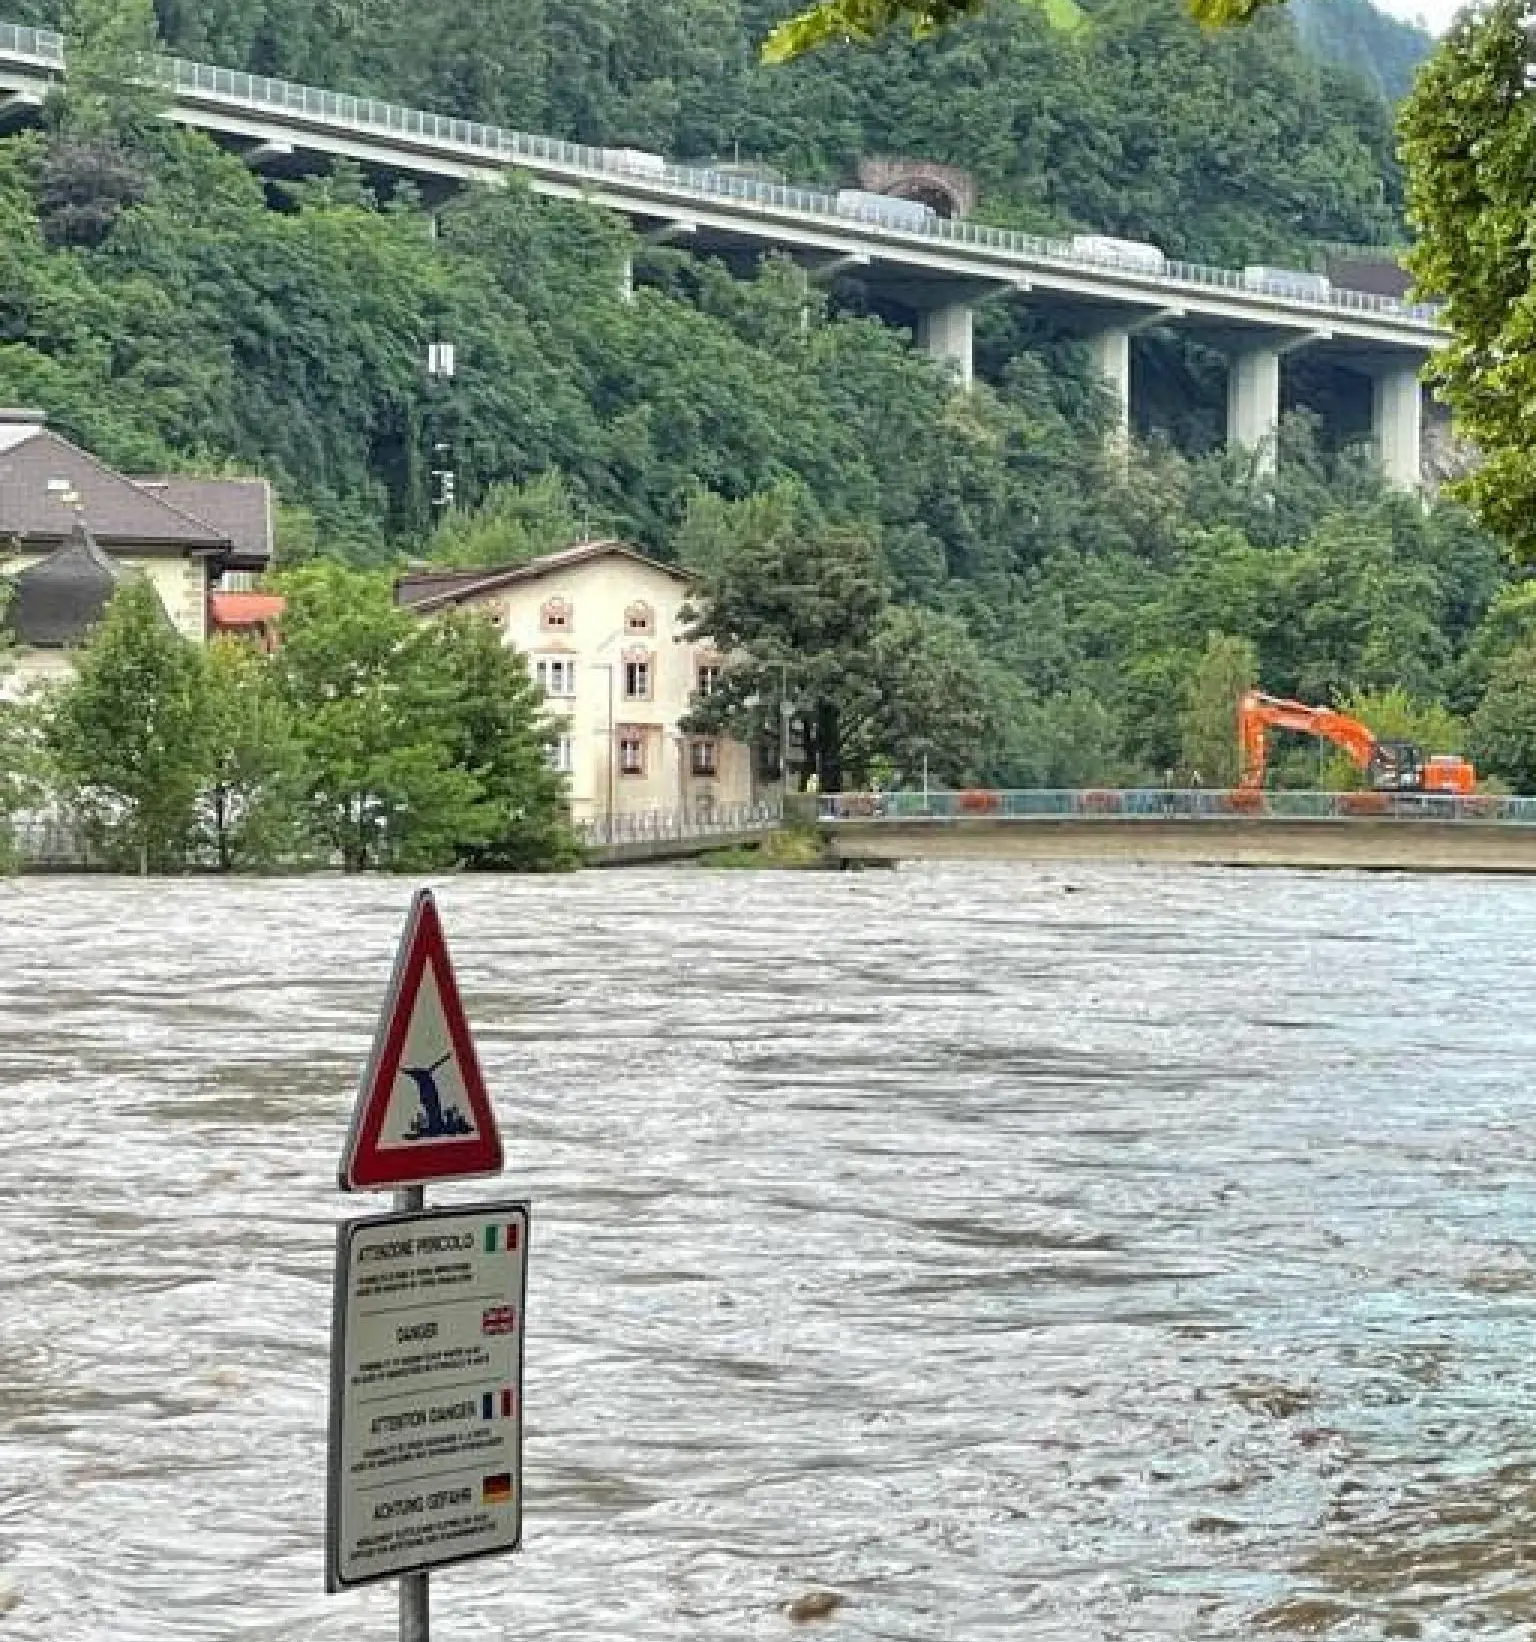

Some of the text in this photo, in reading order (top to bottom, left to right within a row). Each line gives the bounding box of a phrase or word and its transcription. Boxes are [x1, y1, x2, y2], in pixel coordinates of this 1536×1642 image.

[396, 1322, 438, 1343] DANGER
[371, 1401, 476, 1433] ATTENTION DANGER
[373, 1487, 472, 1520] ACHTUNG GEFAHR
